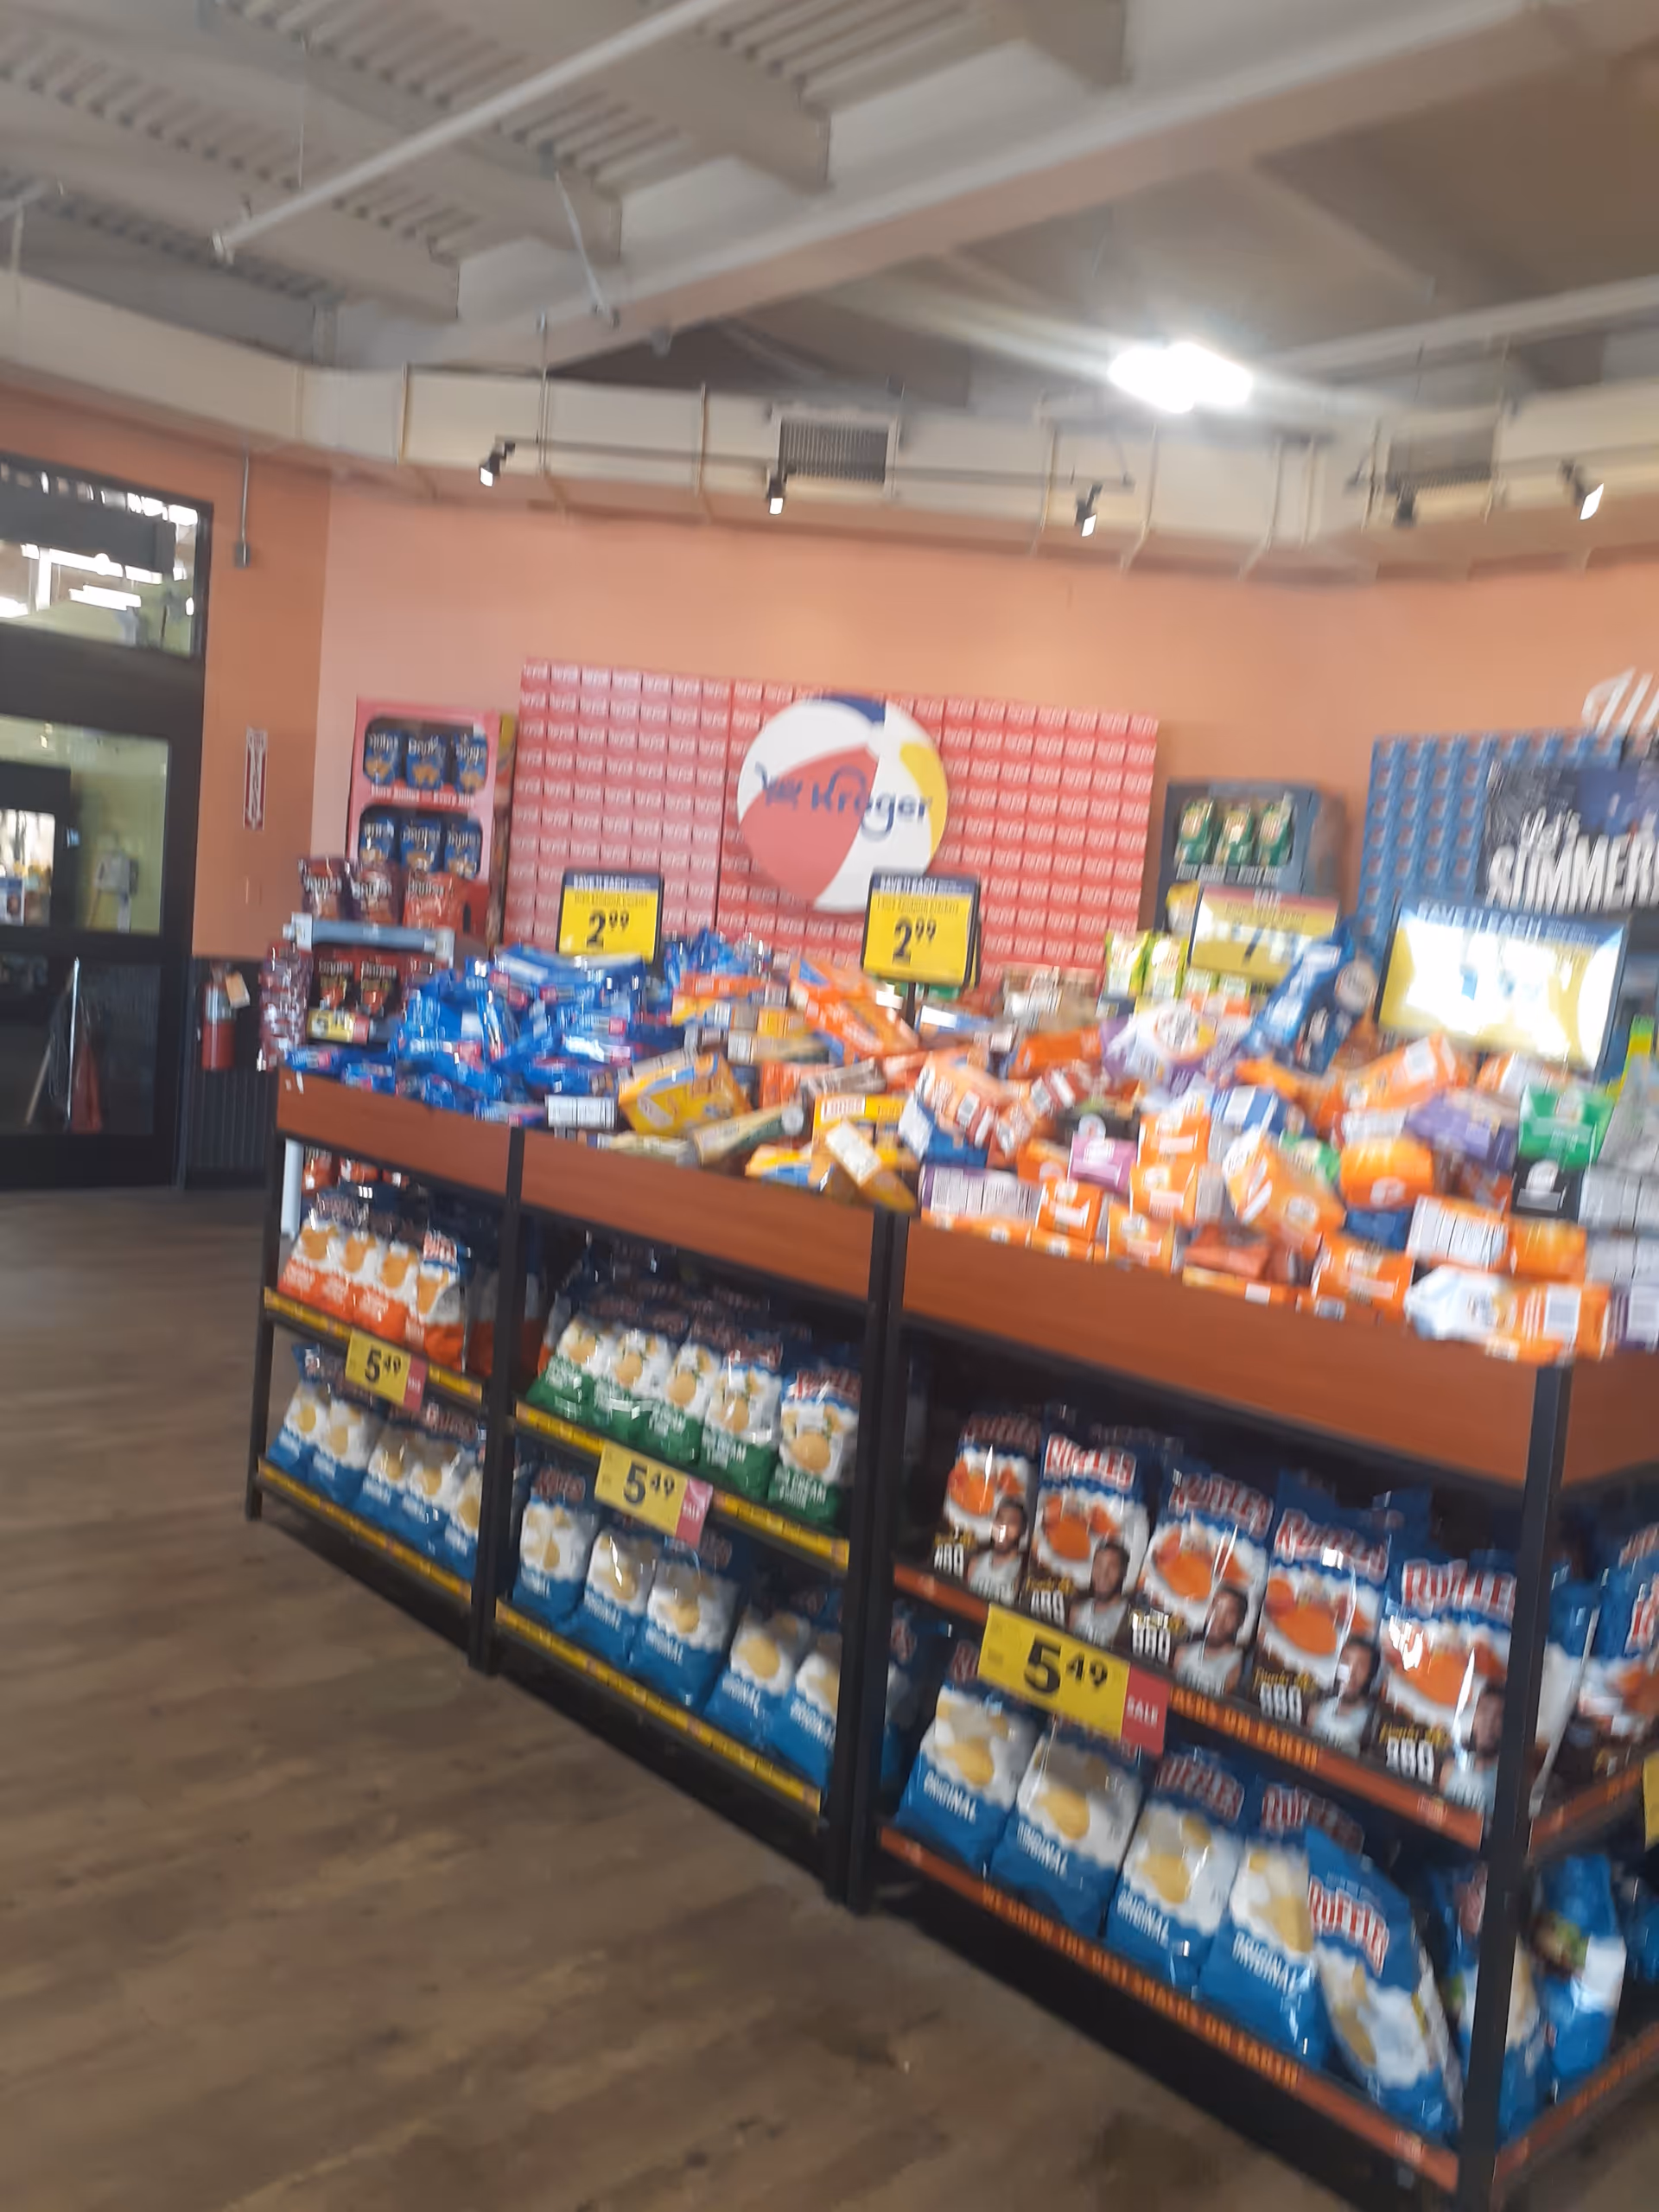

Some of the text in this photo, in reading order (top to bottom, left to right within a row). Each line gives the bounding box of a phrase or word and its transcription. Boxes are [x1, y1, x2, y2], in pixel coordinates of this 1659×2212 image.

[811, 765, 933, 842] Kroger
[1484, 835, 1659, 913] SUMMER
[1127, 1694, 1159, 1726] SALE
[1223, 1706, 1251, 1742] ON
[1256, 1719, 1319, 1770] EARTH
[1308, 1875, 1390, 1978] RUFFLES
